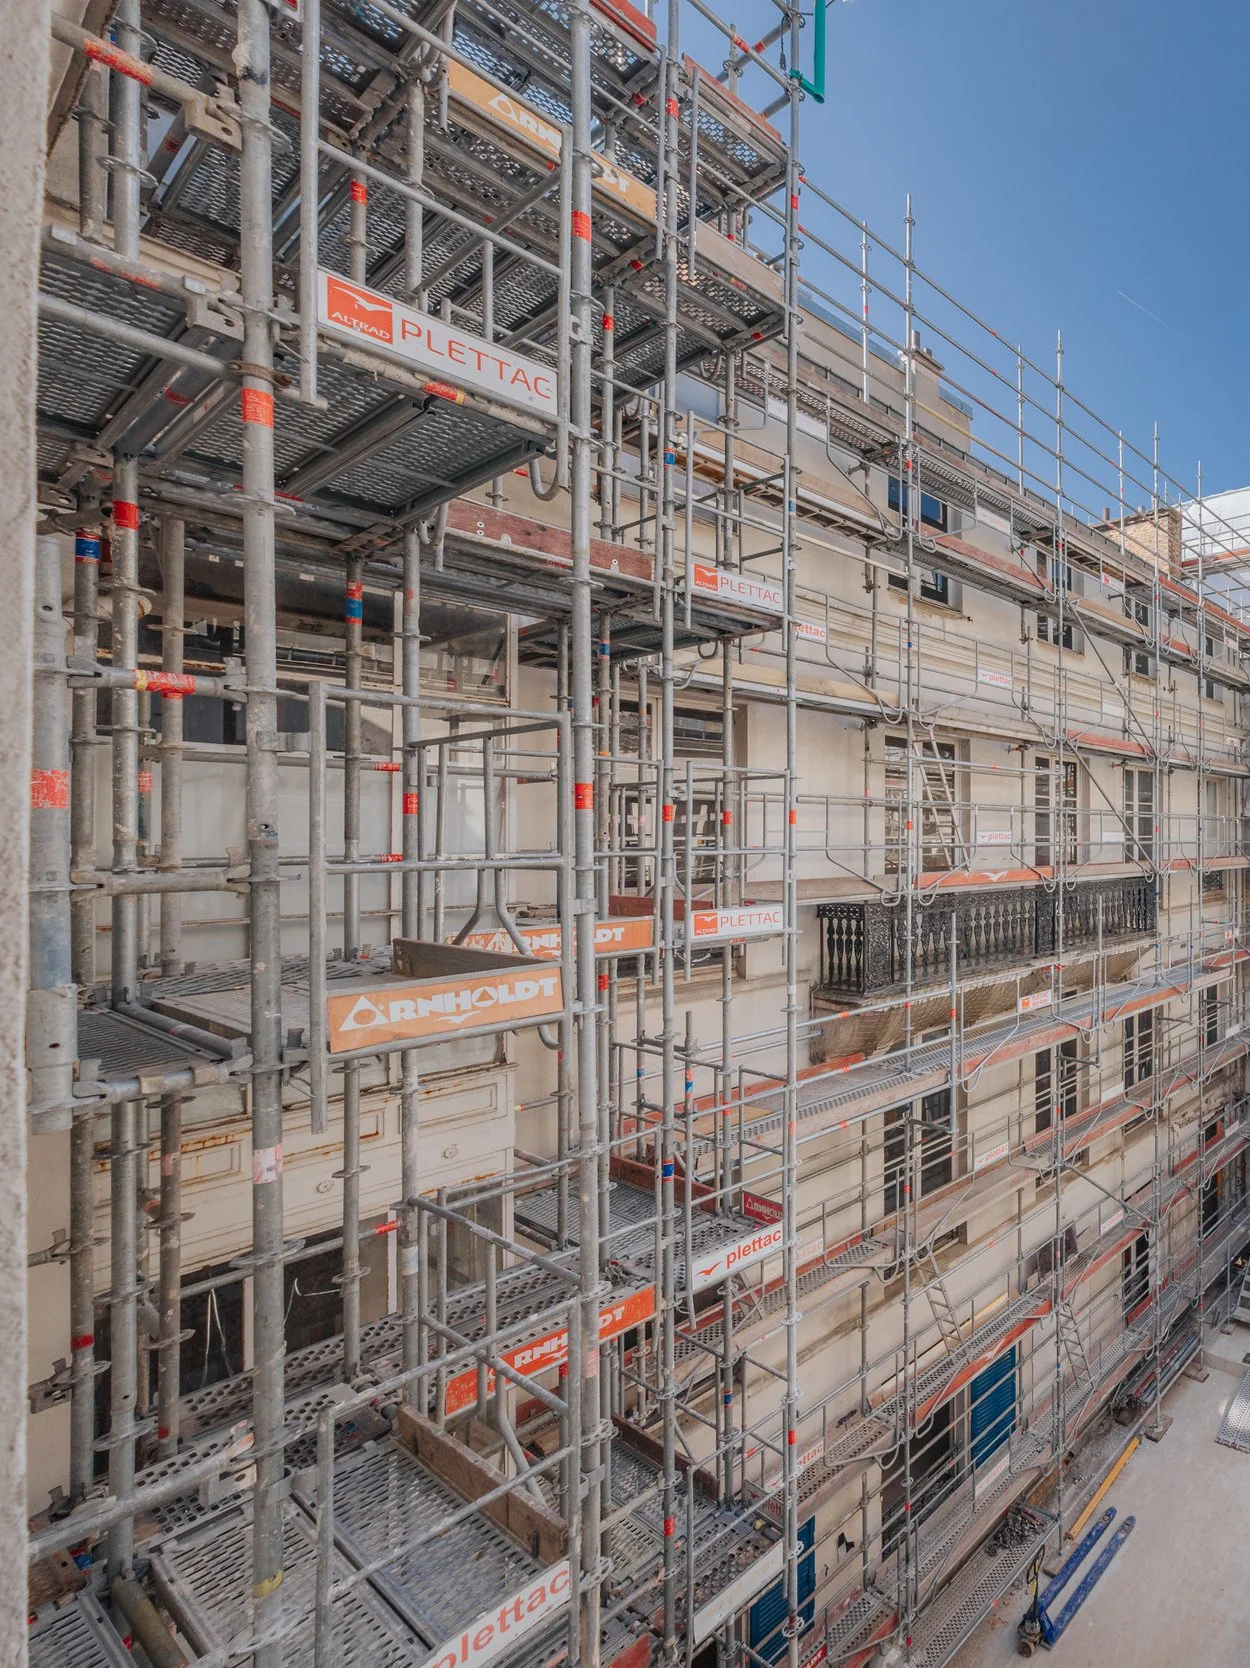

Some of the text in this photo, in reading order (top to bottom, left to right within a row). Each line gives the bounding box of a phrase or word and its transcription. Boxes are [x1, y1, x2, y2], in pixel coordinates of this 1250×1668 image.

[331, 310, 390, 340] ALTRAD
[401, 318, 552, 400] PLETTAC
[695, 580, 717, 590] ALTRAD
[720, 576, 781, 604] PLETTAC
[695, 928, 717, 936] ALTRAD
[720, 911, 781, 928] PLETTAC
[339, 977, 558, 1032] ARNHOLDT
[725, 1229, 782, 1269] plettac
